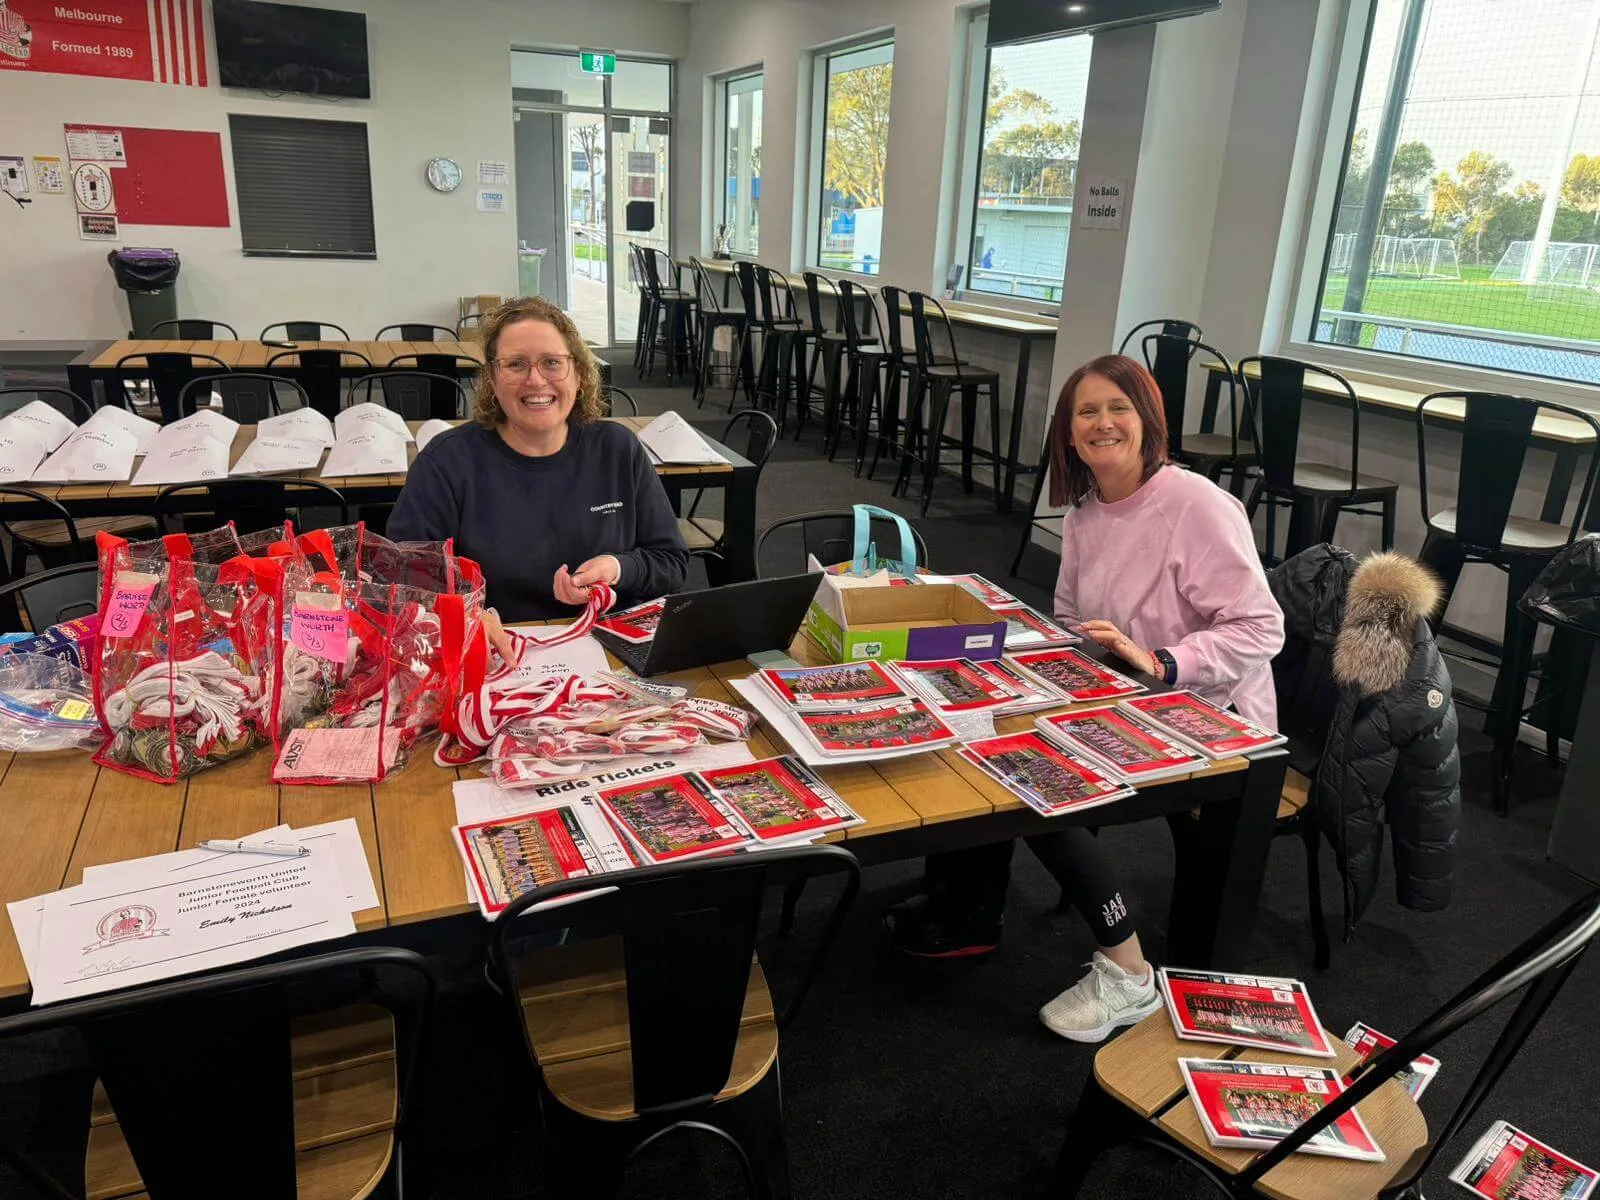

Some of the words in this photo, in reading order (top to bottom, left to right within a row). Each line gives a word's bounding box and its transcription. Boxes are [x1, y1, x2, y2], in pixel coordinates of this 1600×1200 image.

[54, 6, 123, 24] Melbourne
[52, 40, 101, 55] Formed
[104, 46, 134, 58] 1989
[1089, 186, 1100, 196] No
[1101, 186, 1119, 196] Balls
[1087, 204, 1117, 217] Inside
[535, 779, 590, 798] Ride
[592, 760, 676, 784] Tickets
[177, 902, 213, 914] Junior
[215, 893, 257, 905] Female
[259, 880, 312, 896] volunteer
[188, 892, 223, 903] Junior
[225, 882, 271, 895] Football
[273, 875, 300, 885] Club
[234, 899, 261, 909] 2024
[1102, 892, 1122, 915] JAG
[199, 916, 236, 929] Emily
[238, 904, 293, 919] Nicholson
